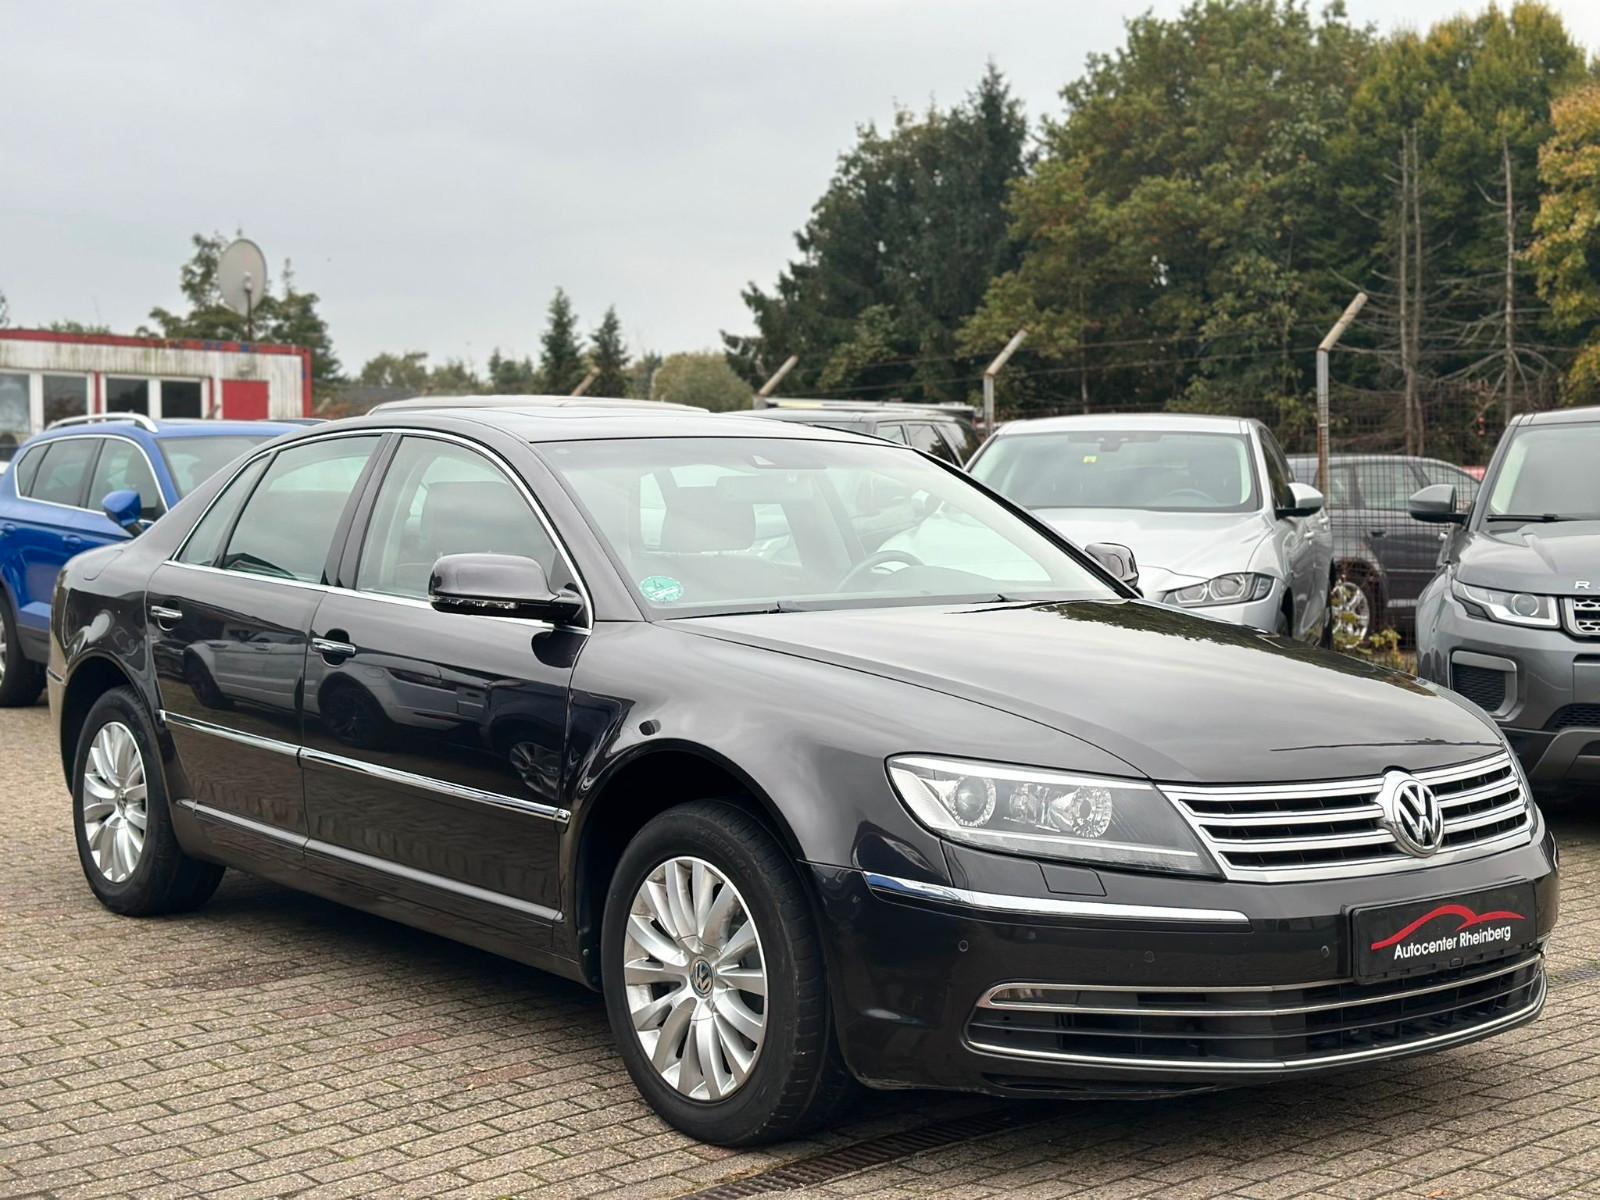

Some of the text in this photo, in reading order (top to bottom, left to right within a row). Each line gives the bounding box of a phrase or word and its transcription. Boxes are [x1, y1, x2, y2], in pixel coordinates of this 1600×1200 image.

[1396, 782, 1441, 850] VW
[1394, 926, 1512, 960] Autocenter Rheinberg
